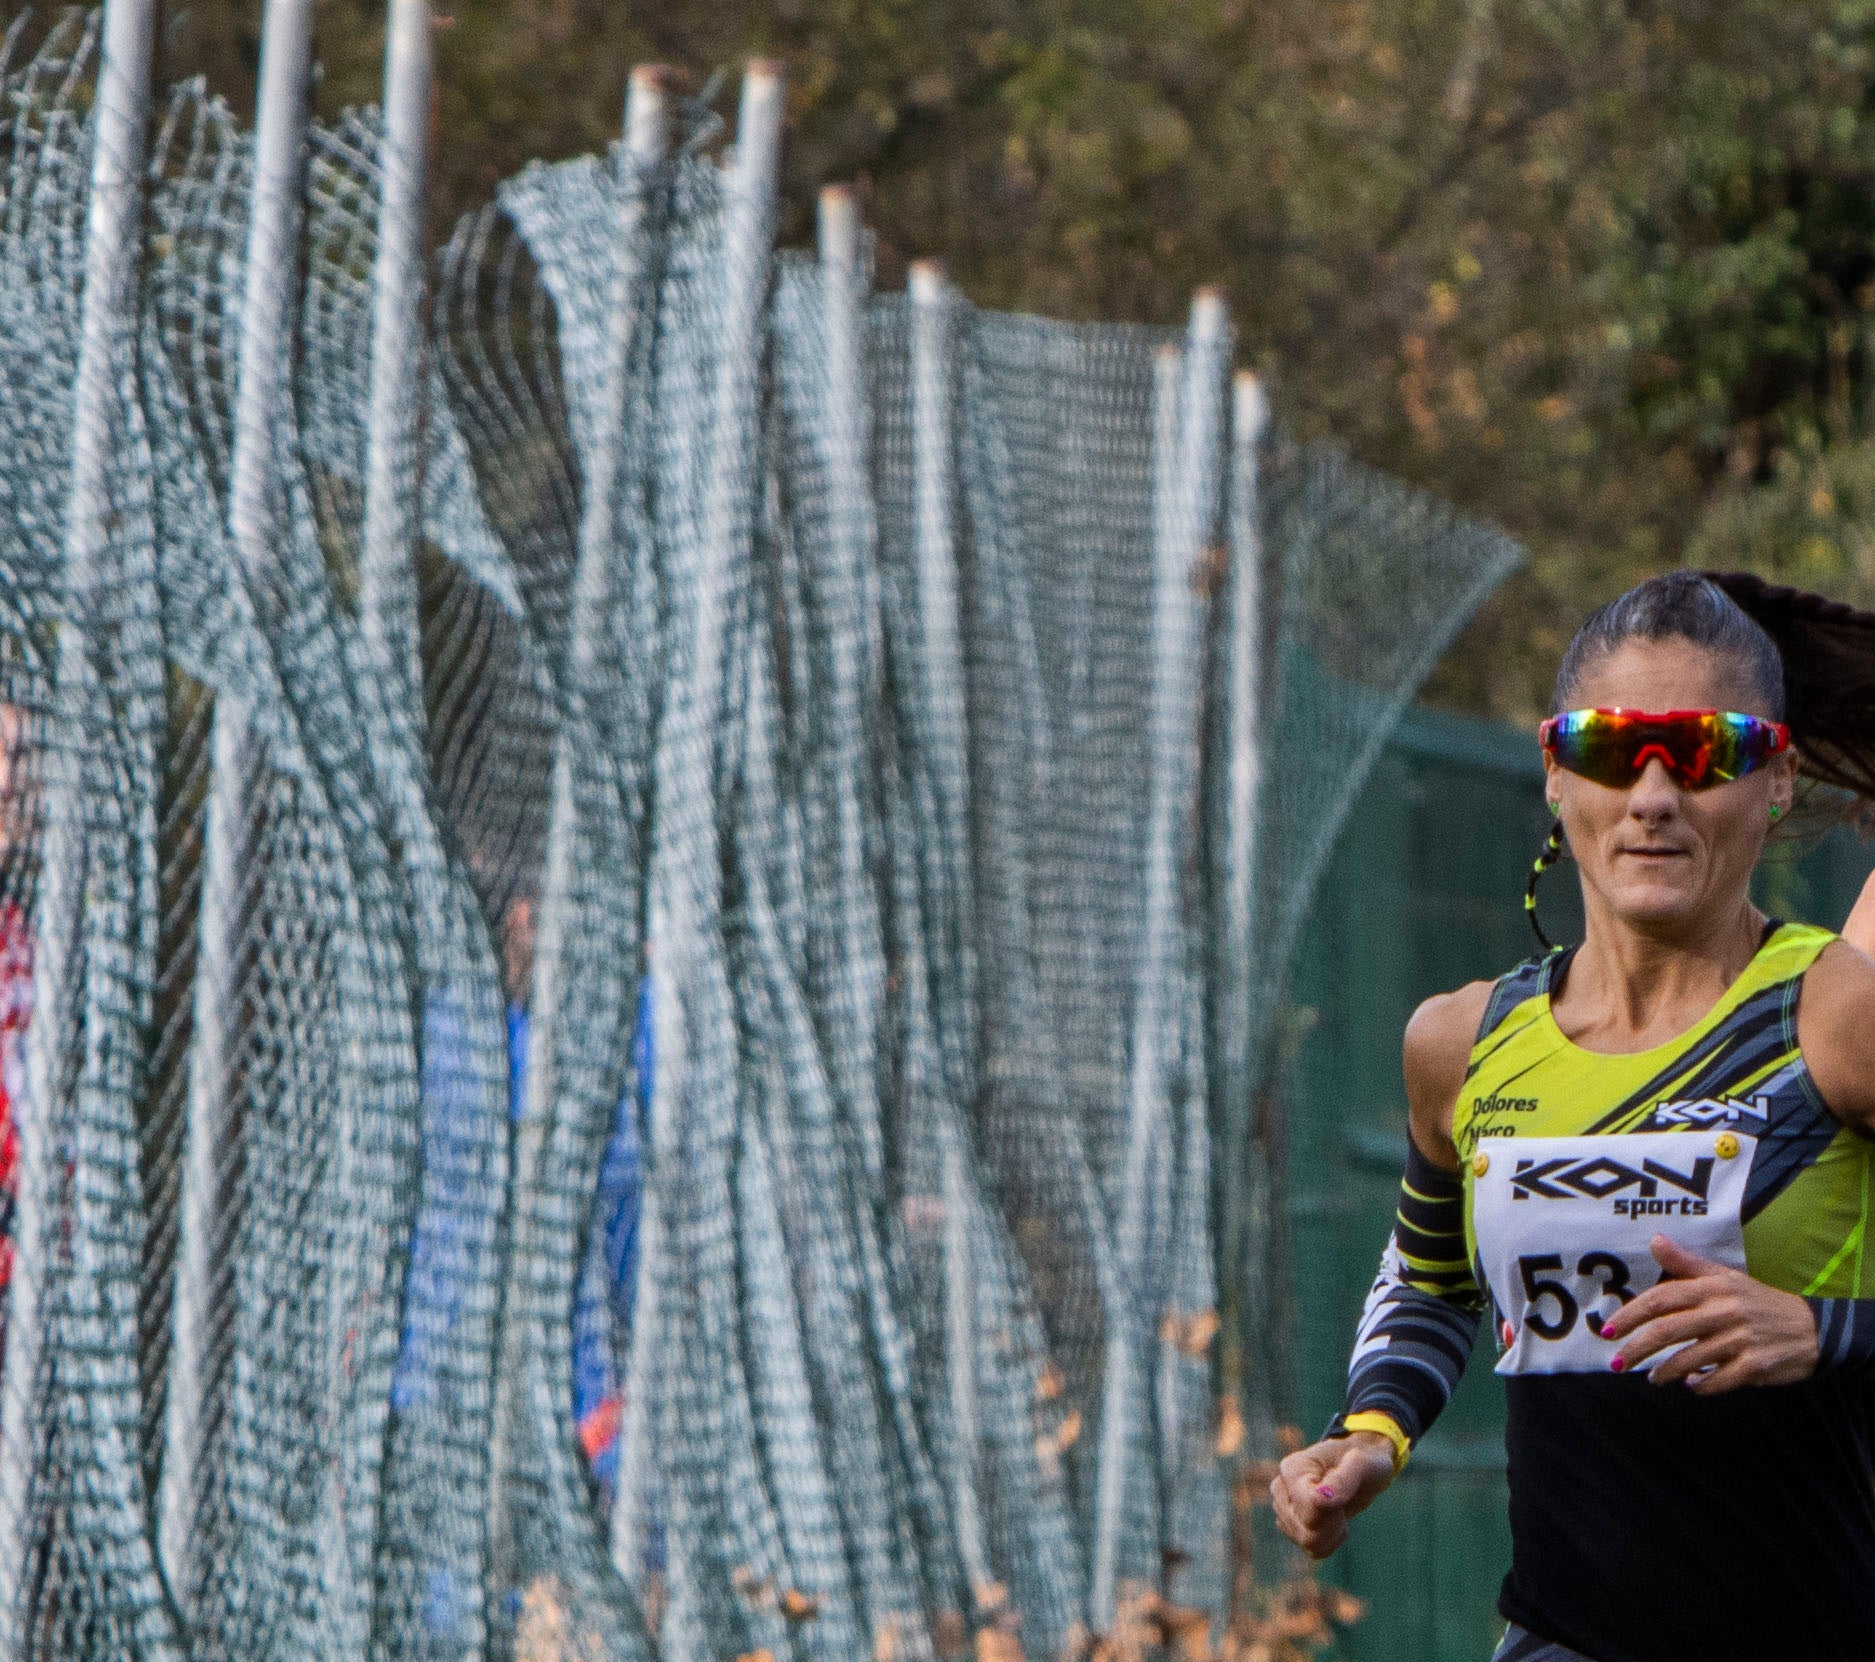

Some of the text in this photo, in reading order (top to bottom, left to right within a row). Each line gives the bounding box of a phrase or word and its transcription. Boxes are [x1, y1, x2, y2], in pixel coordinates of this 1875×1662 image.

[1473, 1096, 1539, 1116] Dolores
[1656, 1097, 1768, 1125] KON
[1509, 1156, 1715, 1201] KON
[1613, 1198, 1709, 1220] sports
